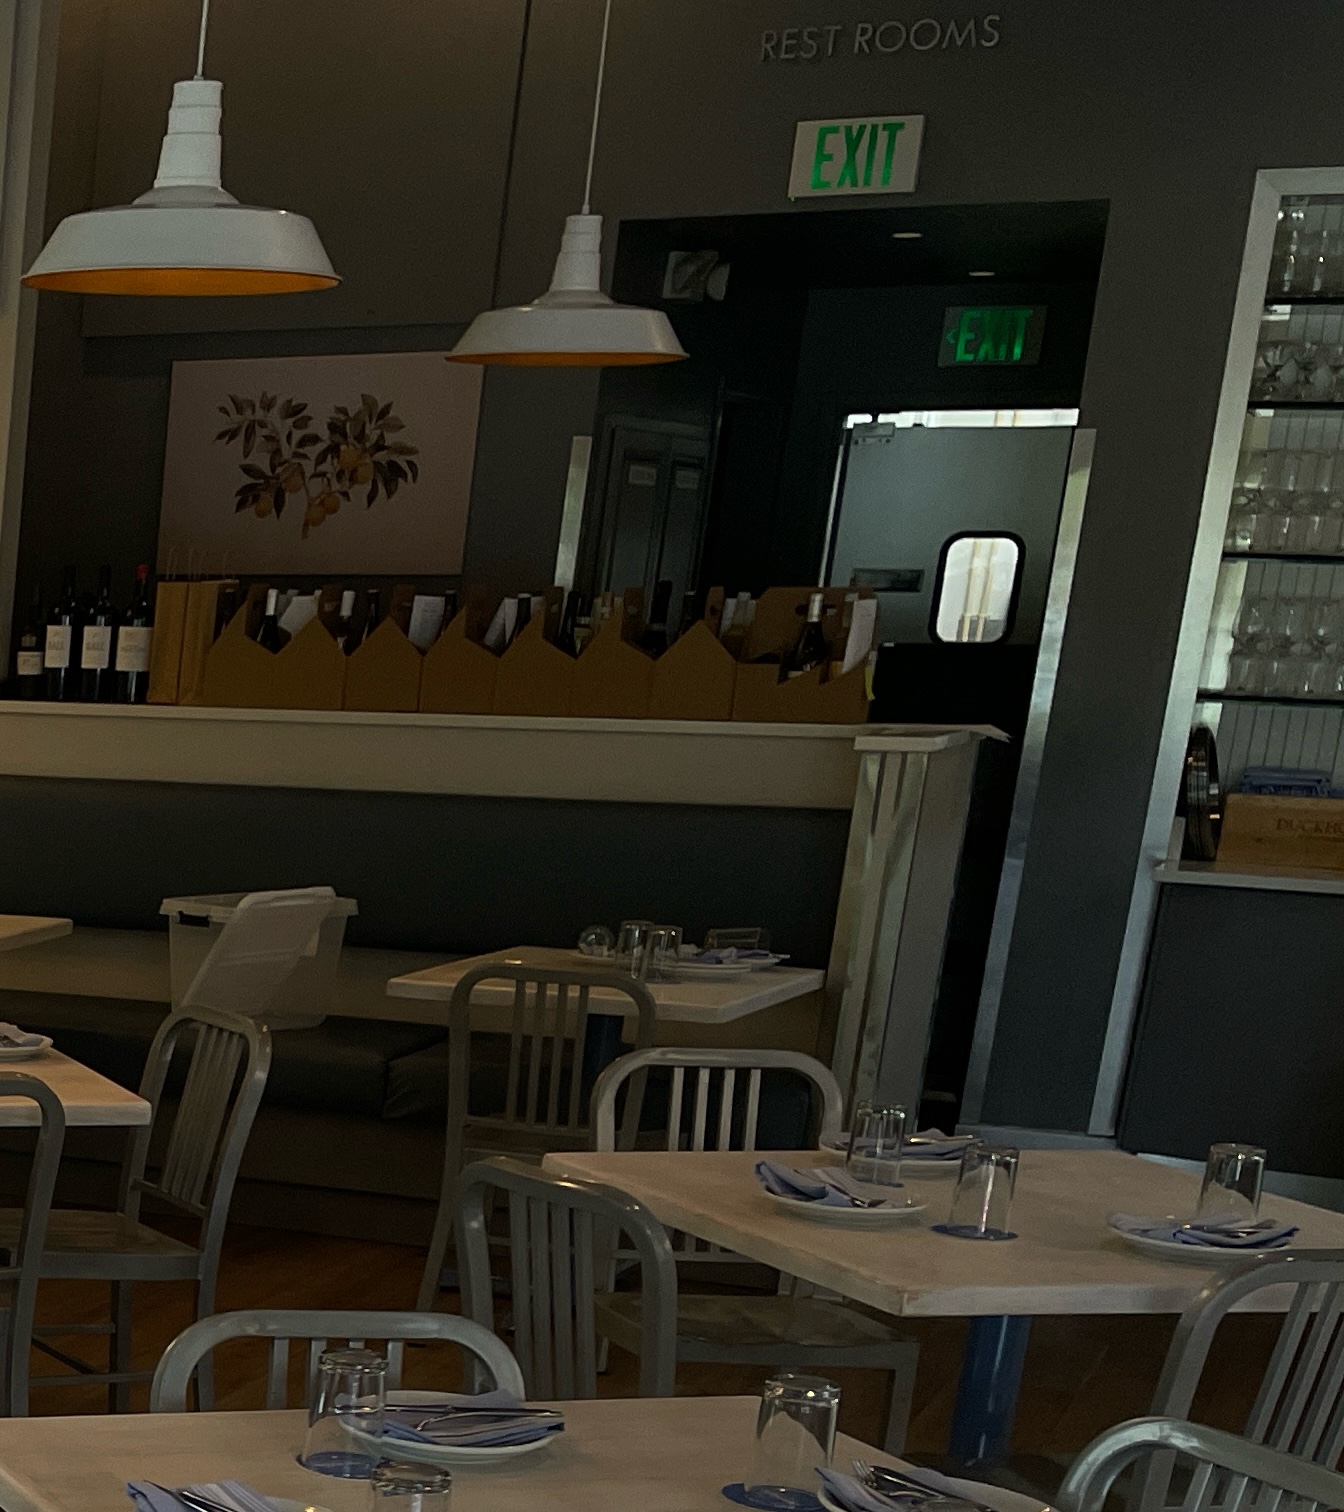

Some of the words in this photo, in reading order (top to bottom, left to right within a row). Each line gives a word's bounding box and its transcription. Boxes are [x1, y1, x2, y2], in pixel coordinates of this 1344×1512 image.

[761, 25, 843, 61] REST
[853, 14, 1001, 54] ROOMS
[811, 122, 906, 190] EXIT
[956, 308, 1032, 362] EXIT
